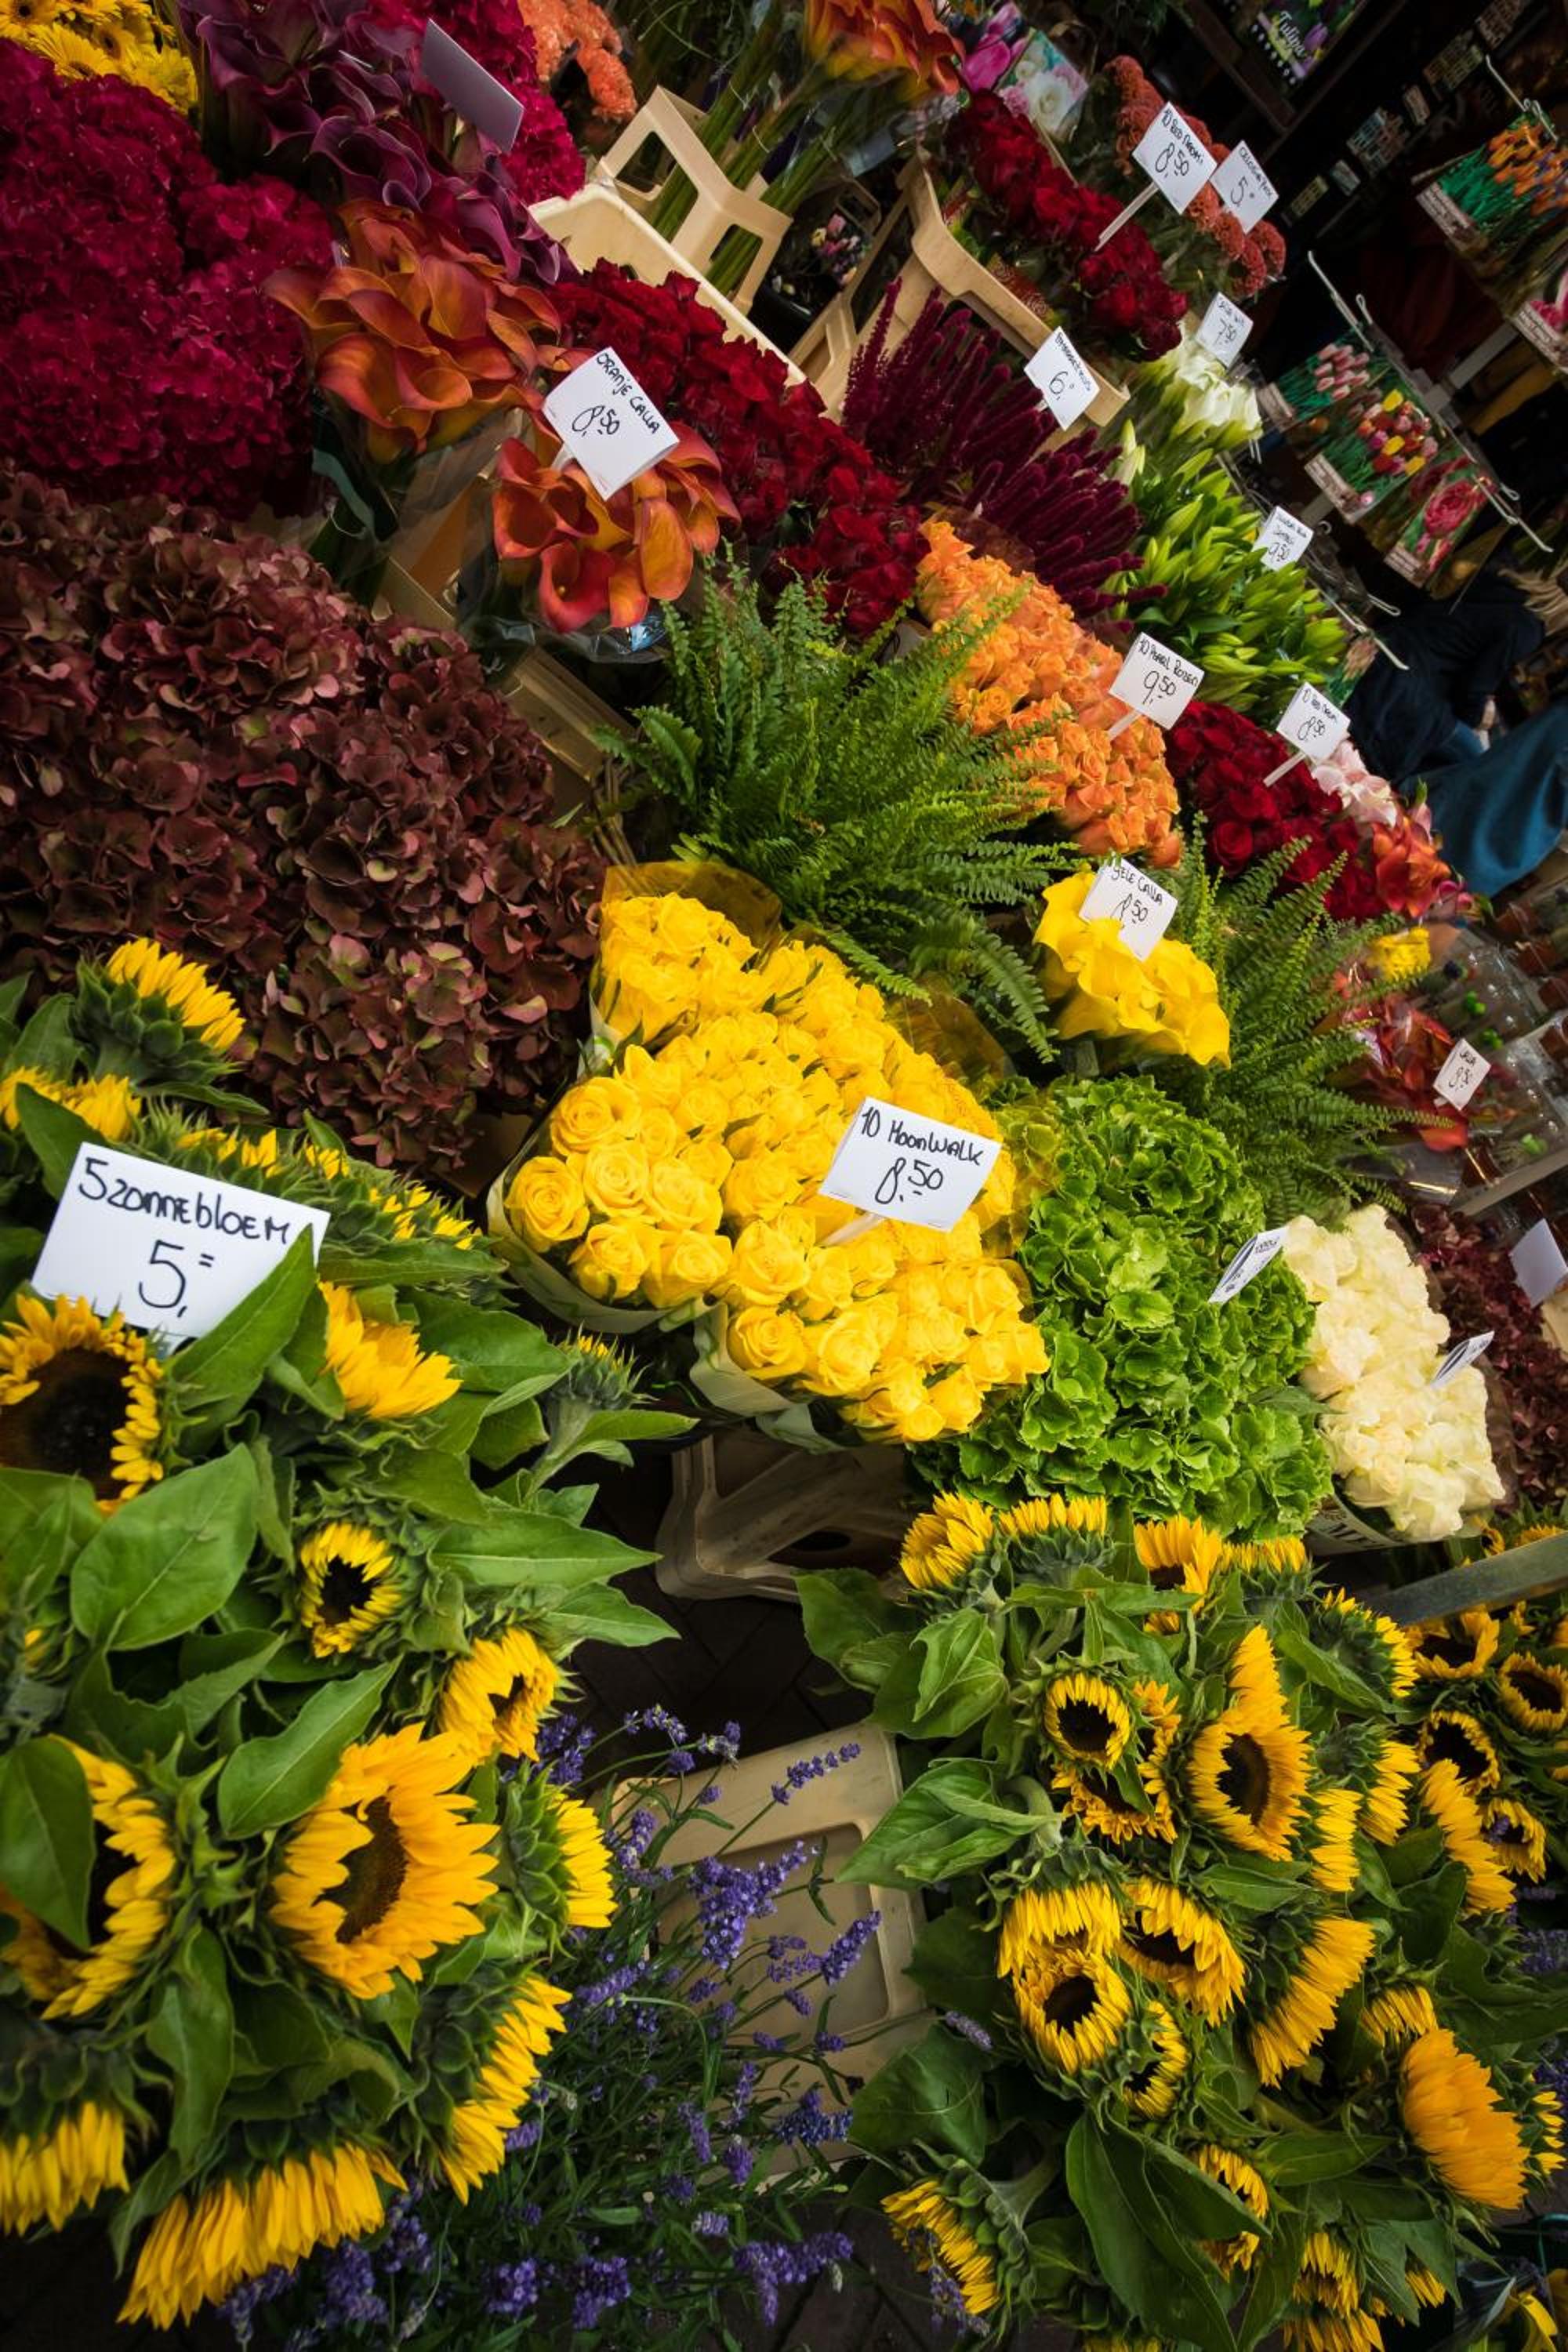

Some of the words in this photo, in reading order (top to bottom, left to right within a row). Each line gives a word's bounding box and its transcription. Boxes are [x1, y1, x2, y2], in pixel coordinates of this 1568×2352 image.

[1279, 10, 1306, 58] Tulipa
[1138, 638, 1150, 655] 10
[861, 1106, 881, 1138] 10
